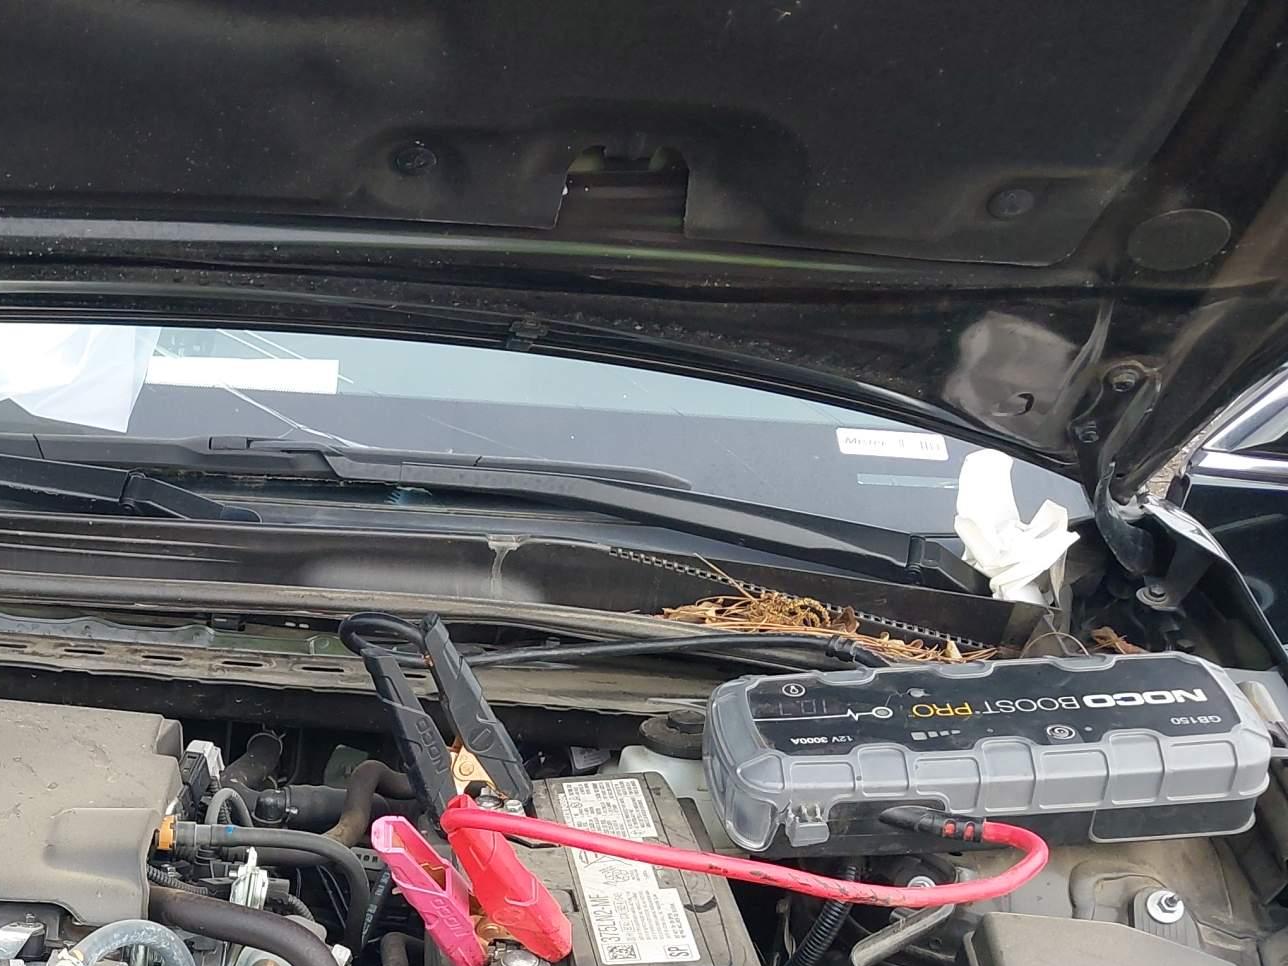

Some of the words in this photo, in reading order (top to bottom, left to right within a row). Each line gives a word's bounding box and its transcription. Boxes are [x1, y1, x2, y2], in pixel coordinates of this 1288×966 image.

[982, 696, 1080, 715] BOOST
[1083, 688, 1208, 708] NOCO
[912, 701, 972, 718] PRO
[1171, 714, 1222, 726] GB150
[416, 718, 448, 775] NOCO
[790, 736, 829, 745] 3000A
[831, 734, 853, 743] 12V
[589, 894, 621, 942] 375LN2-MF
[667, 946, 690, 957] SP
